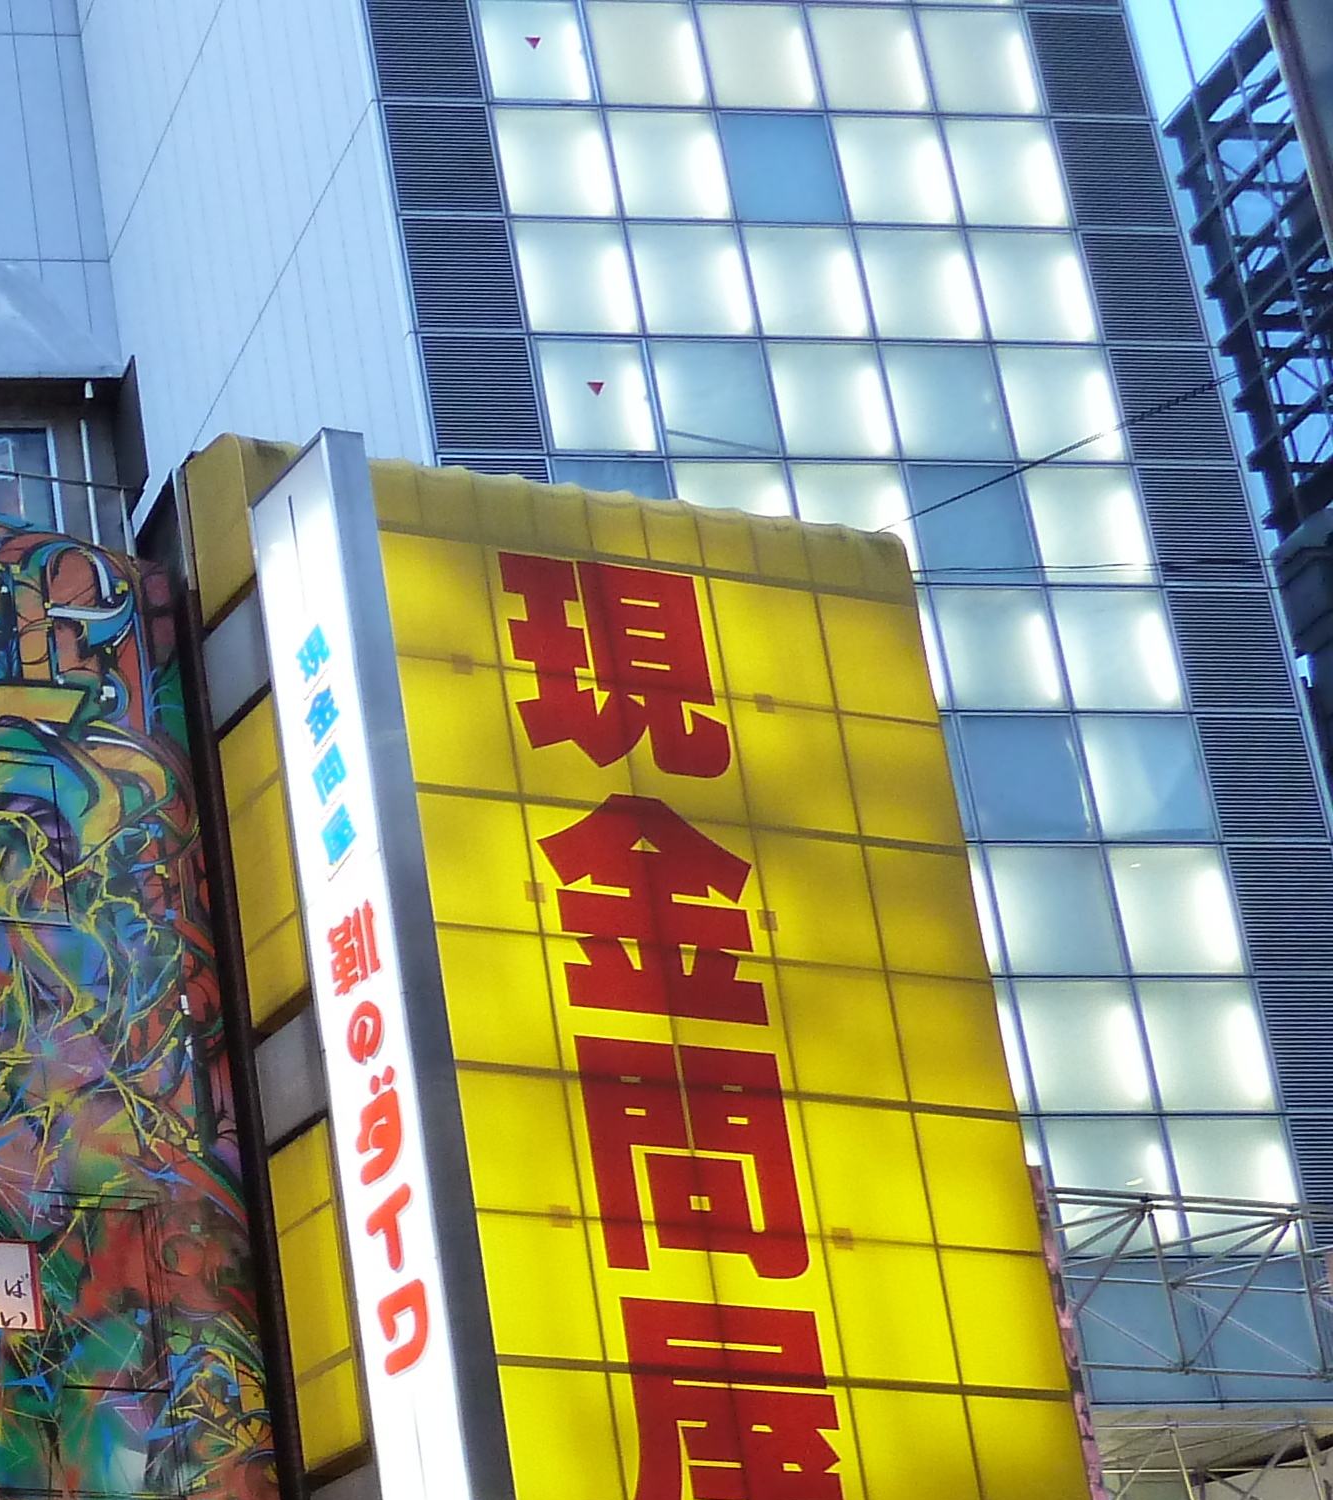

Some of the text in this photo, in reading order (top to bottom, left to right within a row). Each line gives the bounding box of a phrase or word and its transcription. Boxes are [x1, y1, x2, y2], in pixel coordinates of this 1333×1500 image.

[295, 622, 358, 866] 現金問屋
[327, 897, 432, 1377] 靴のダイワ
